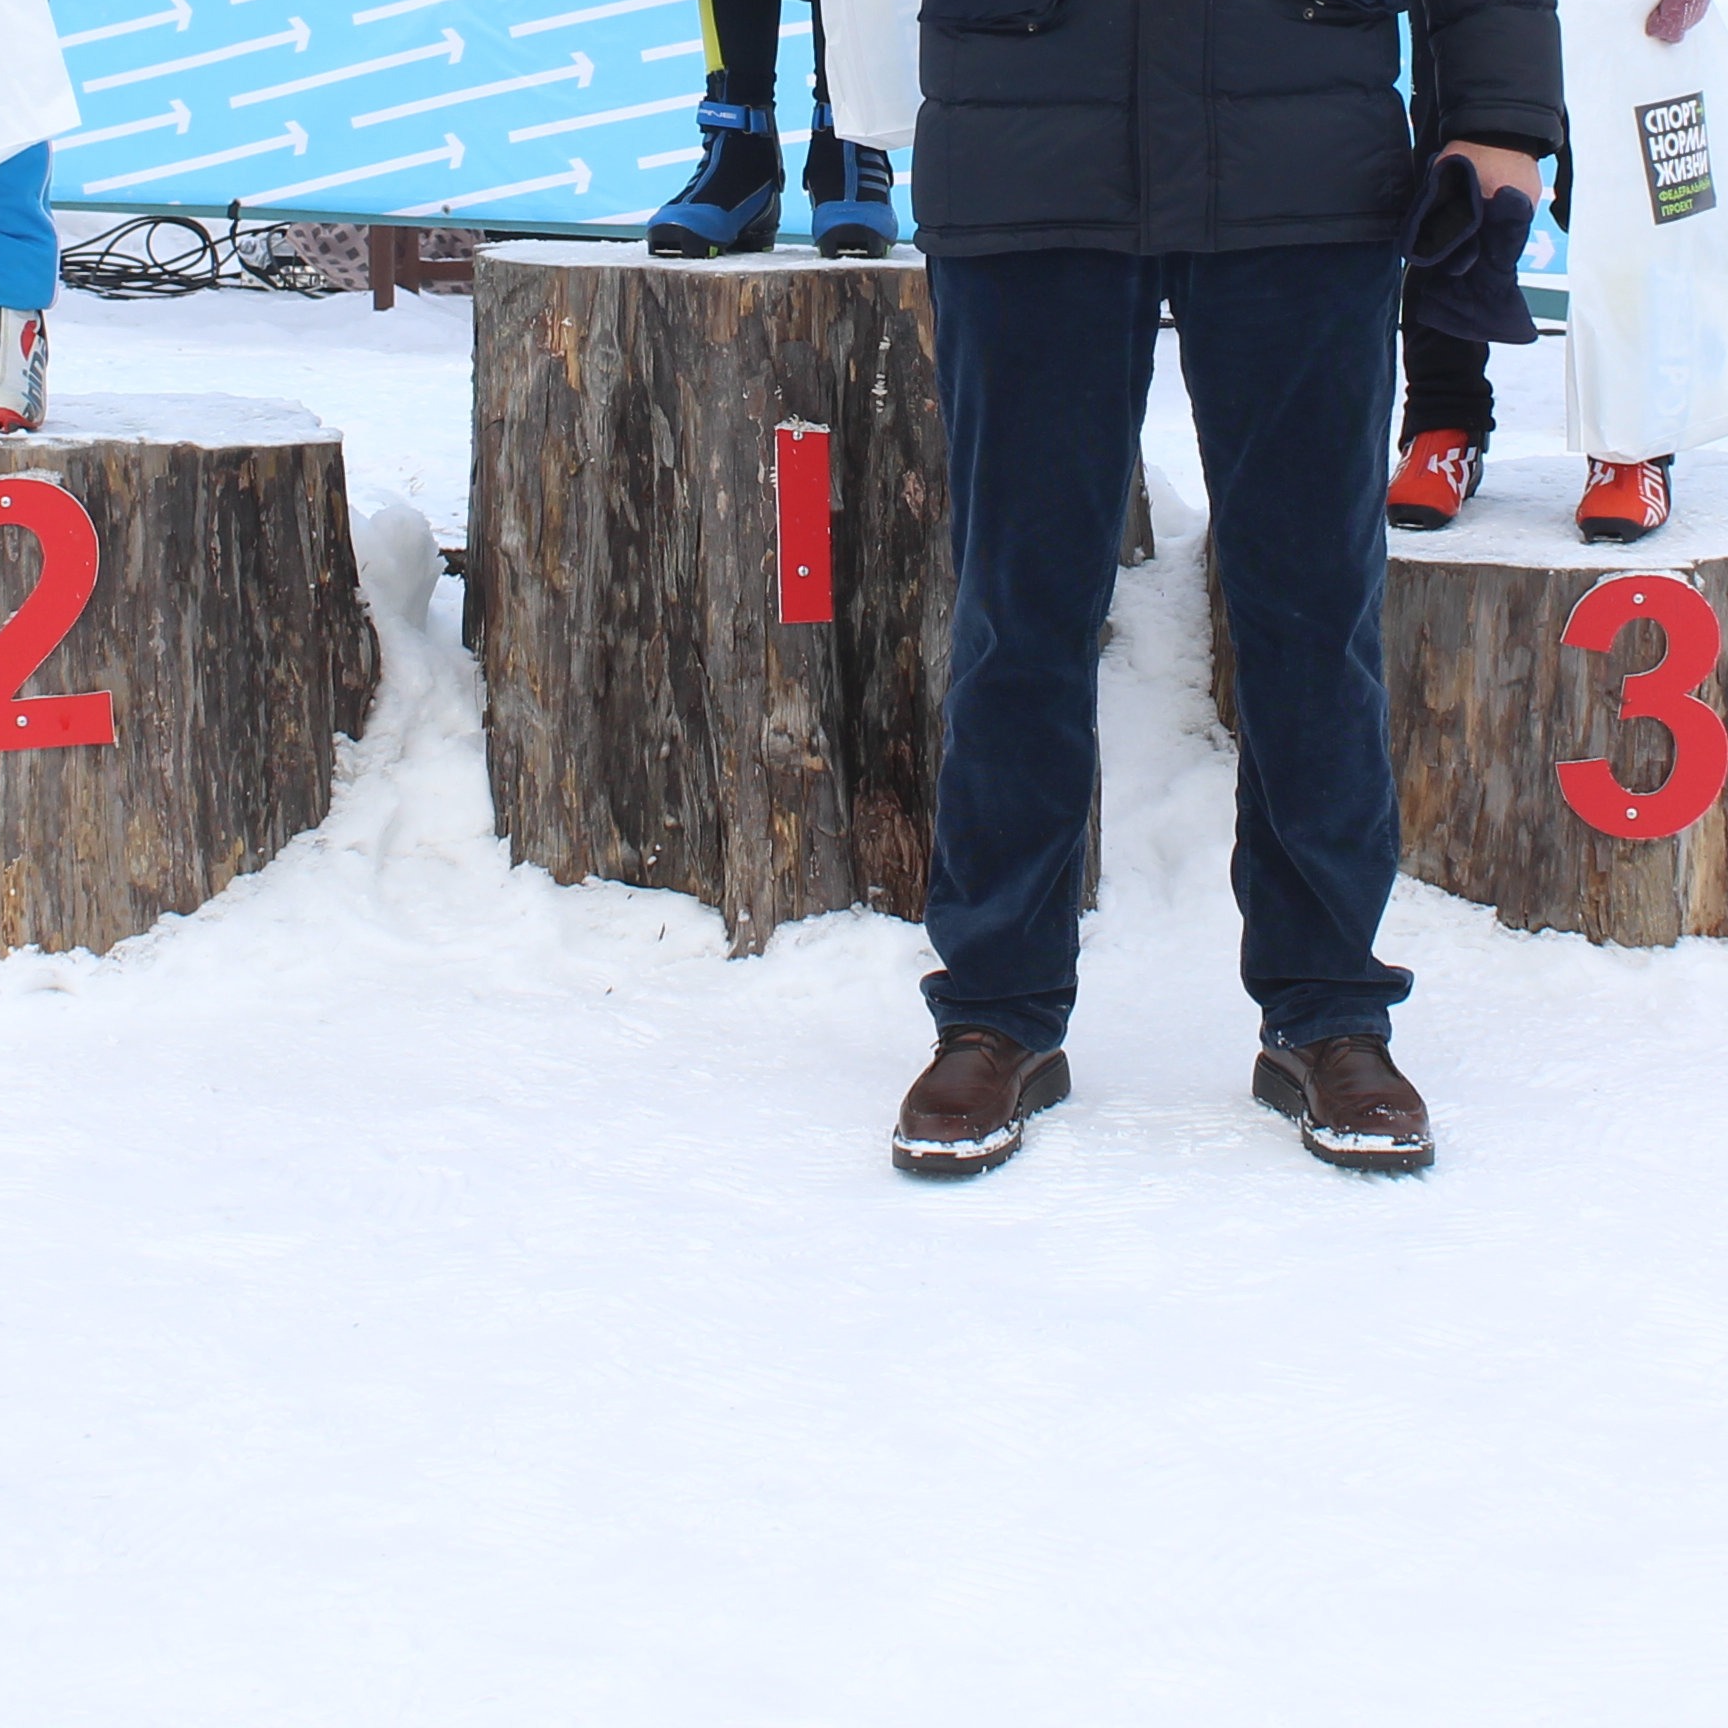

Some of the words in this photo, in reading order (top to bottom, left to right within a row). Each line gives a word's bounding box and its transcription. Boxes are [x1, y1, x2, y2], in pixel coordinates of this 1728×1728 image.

[1644, 100, 1697, 133] СПОРТ
[1648, 124, 1707, 161] НОРМА
[1654, 150, 1709, 187] ЖИЗНИ
[1658, 177, 1710, 202] ФЕДЕРАЛЬНЫЙ
[1661, 198, 1694, 217] ПРОЕКТ
